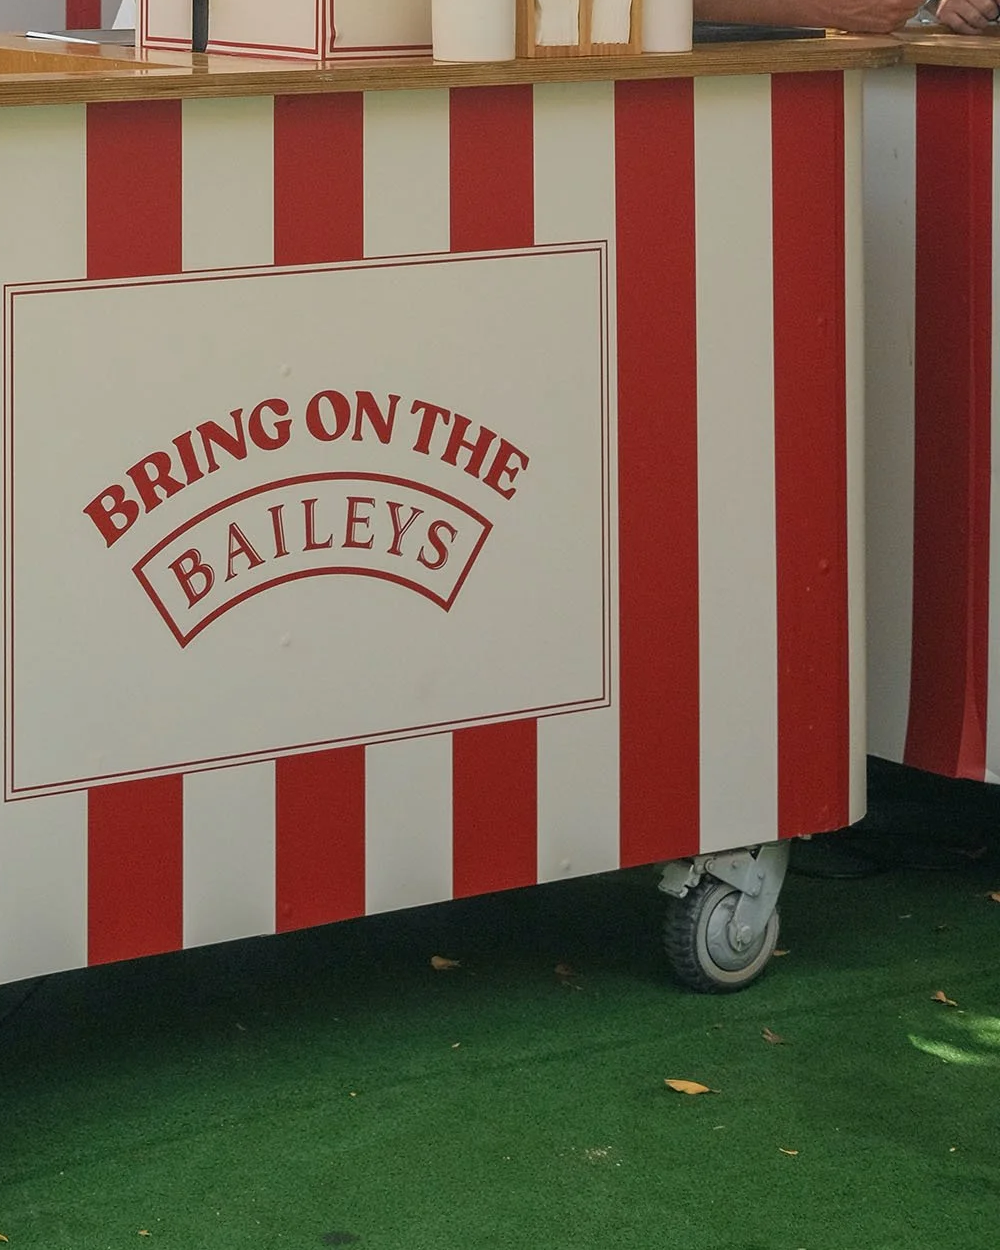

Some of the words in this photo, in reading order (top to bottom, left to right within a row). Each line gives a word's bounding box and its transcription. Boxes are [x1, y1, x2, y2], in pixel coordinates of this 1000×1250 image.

[83, 398, 292, 548] BRING
[306, 390, 401, 445] ON
[410, 399, 530, 501] THE
[168, 496, 458, 609] BAILEYS
